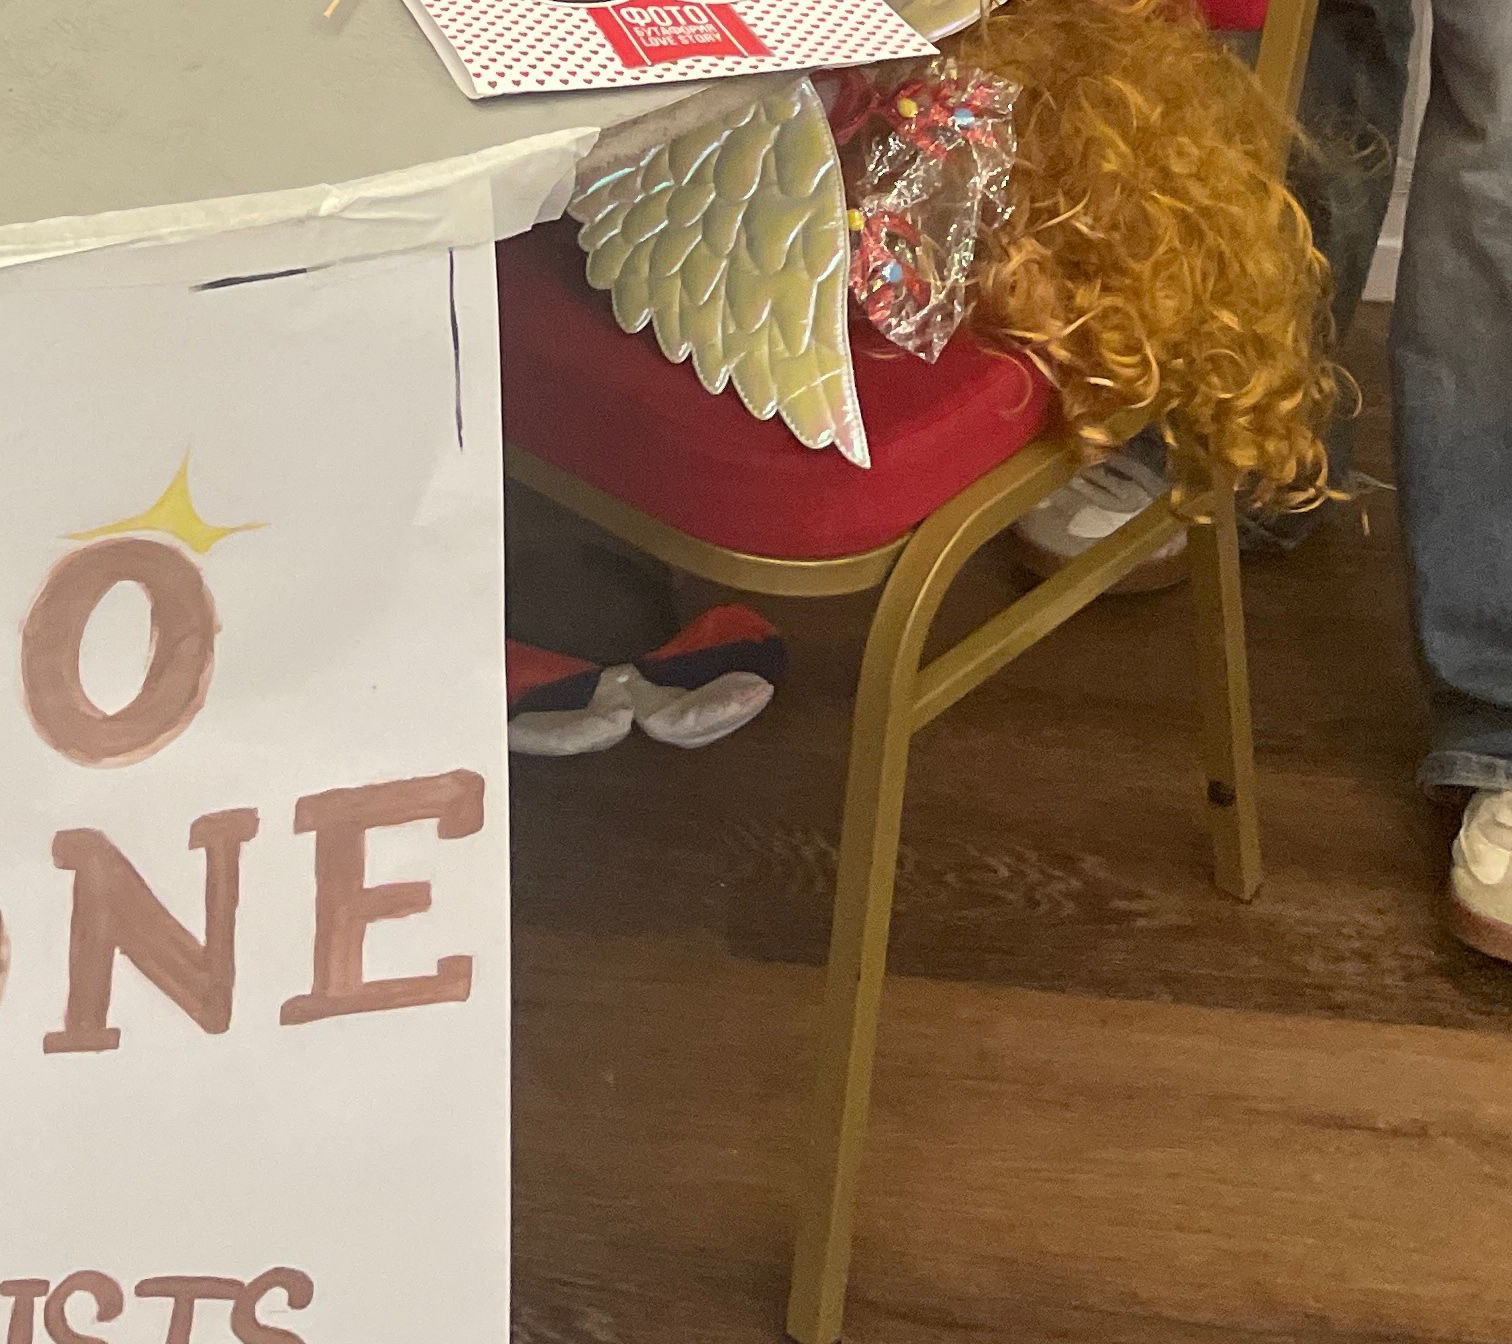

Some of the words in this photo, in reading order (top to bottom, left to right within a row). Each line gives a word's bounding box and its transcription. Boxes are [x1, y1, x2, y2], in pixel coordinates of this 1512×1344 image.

[620, 5, 708, 26] ФОТО
[639, 35, 678, 47] LOVE
[677, 32, 723, 45] STORY
